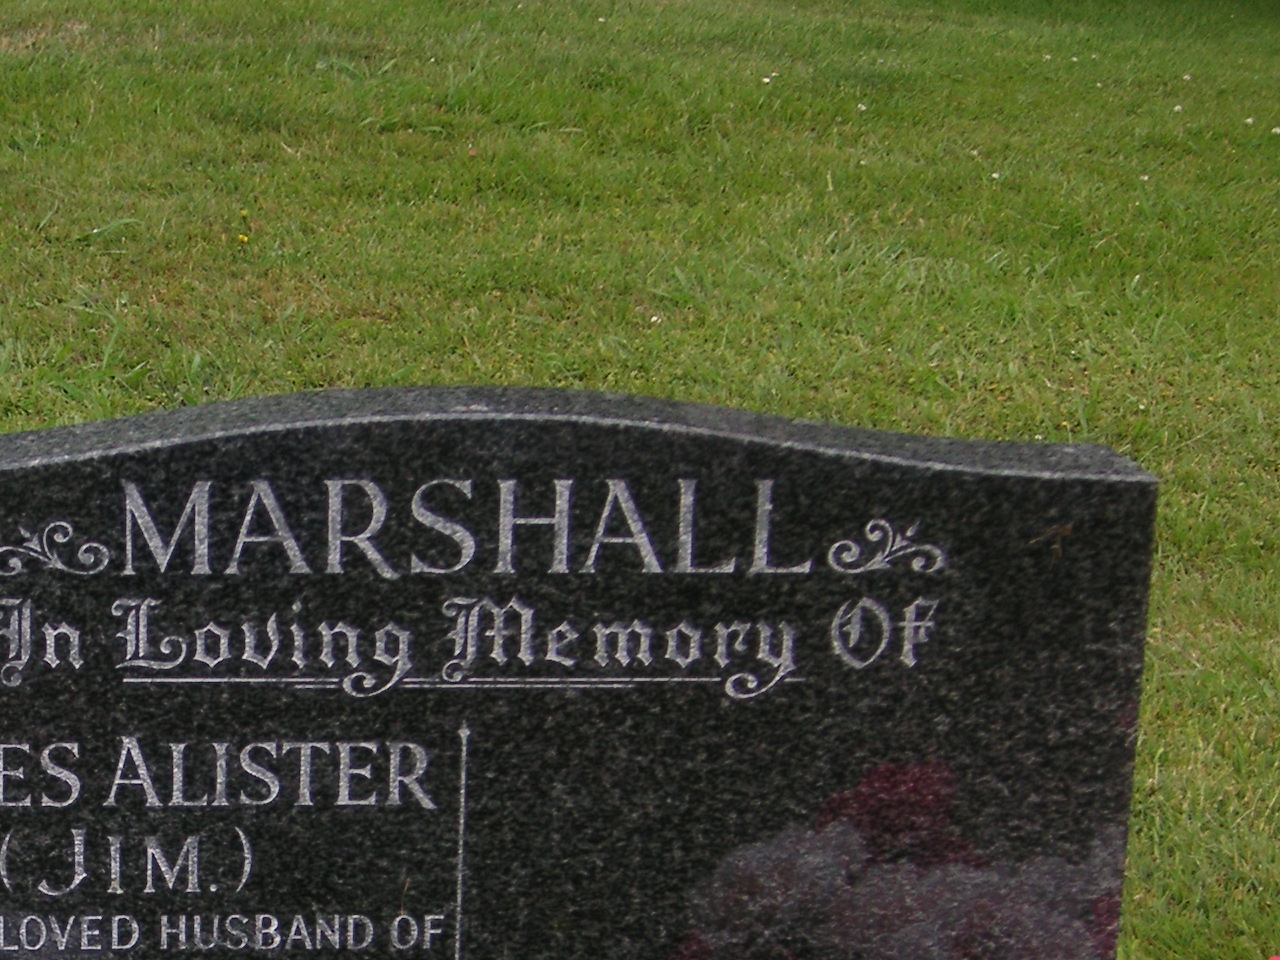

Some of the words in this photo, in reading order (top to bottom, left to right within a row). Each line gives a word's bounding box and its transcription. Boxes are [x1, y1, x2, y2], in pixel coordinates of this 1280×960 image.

[122, 478, 813, 579] MARSHALL
[111, 598, 412, 698] Loving
[441, 597, 797, 699] Memory
[829, 597, 940, 670] Of
[101, 735, 438, 810] ALISTER
[158, 914, 375, 951] HUSBAND
[389, 914, 445, 950] OF
